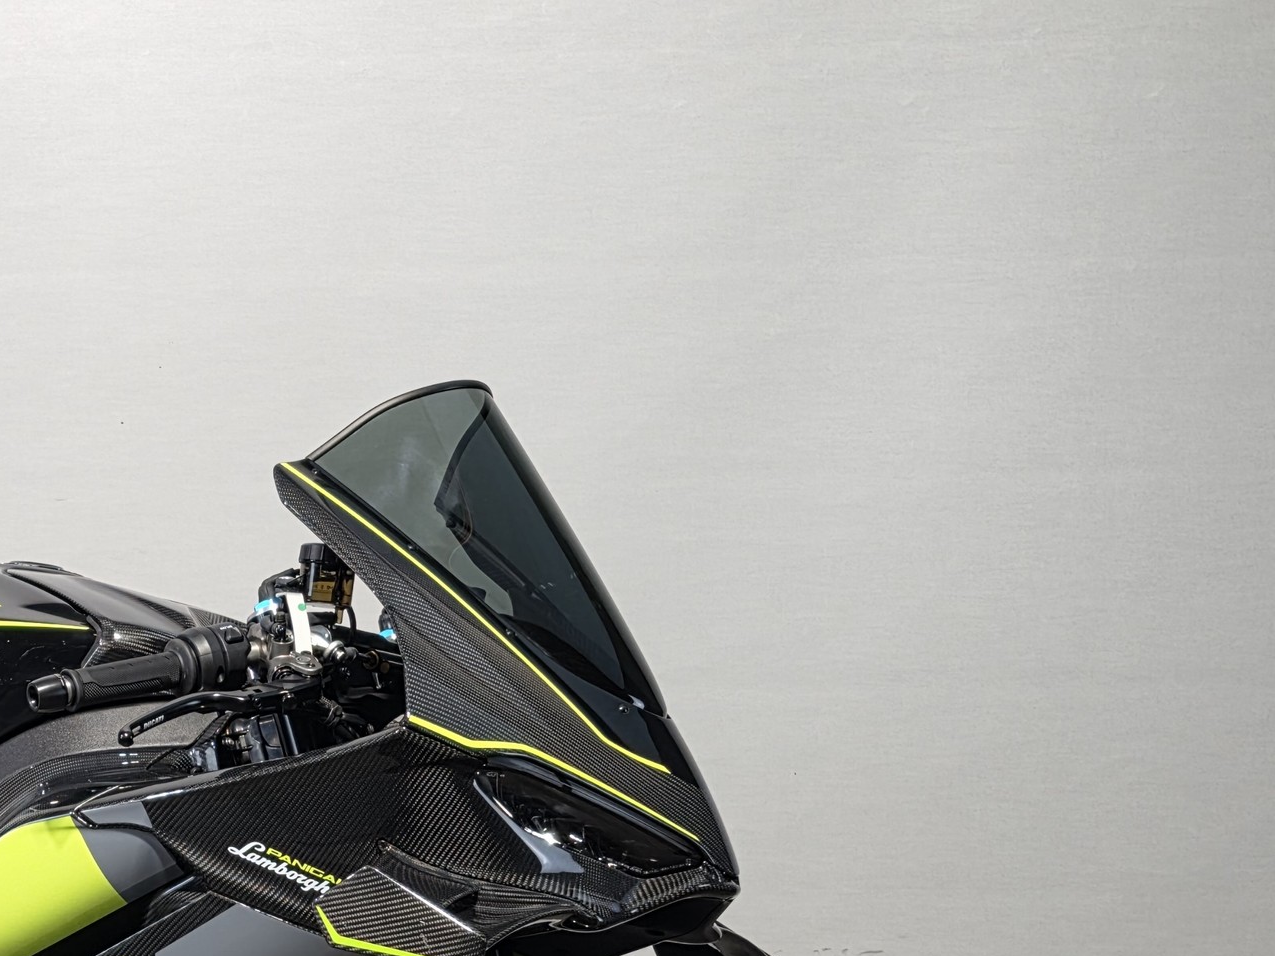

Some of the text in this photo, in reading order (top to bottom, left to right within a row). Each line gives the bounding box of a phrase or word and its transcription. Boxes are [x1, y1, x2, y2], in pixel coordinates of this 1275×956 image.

[143, 714, 165, 730] DUCATI
[227, 841, 331, 894] Lamborgh
[265, 847, 342, 885] PANIGA
